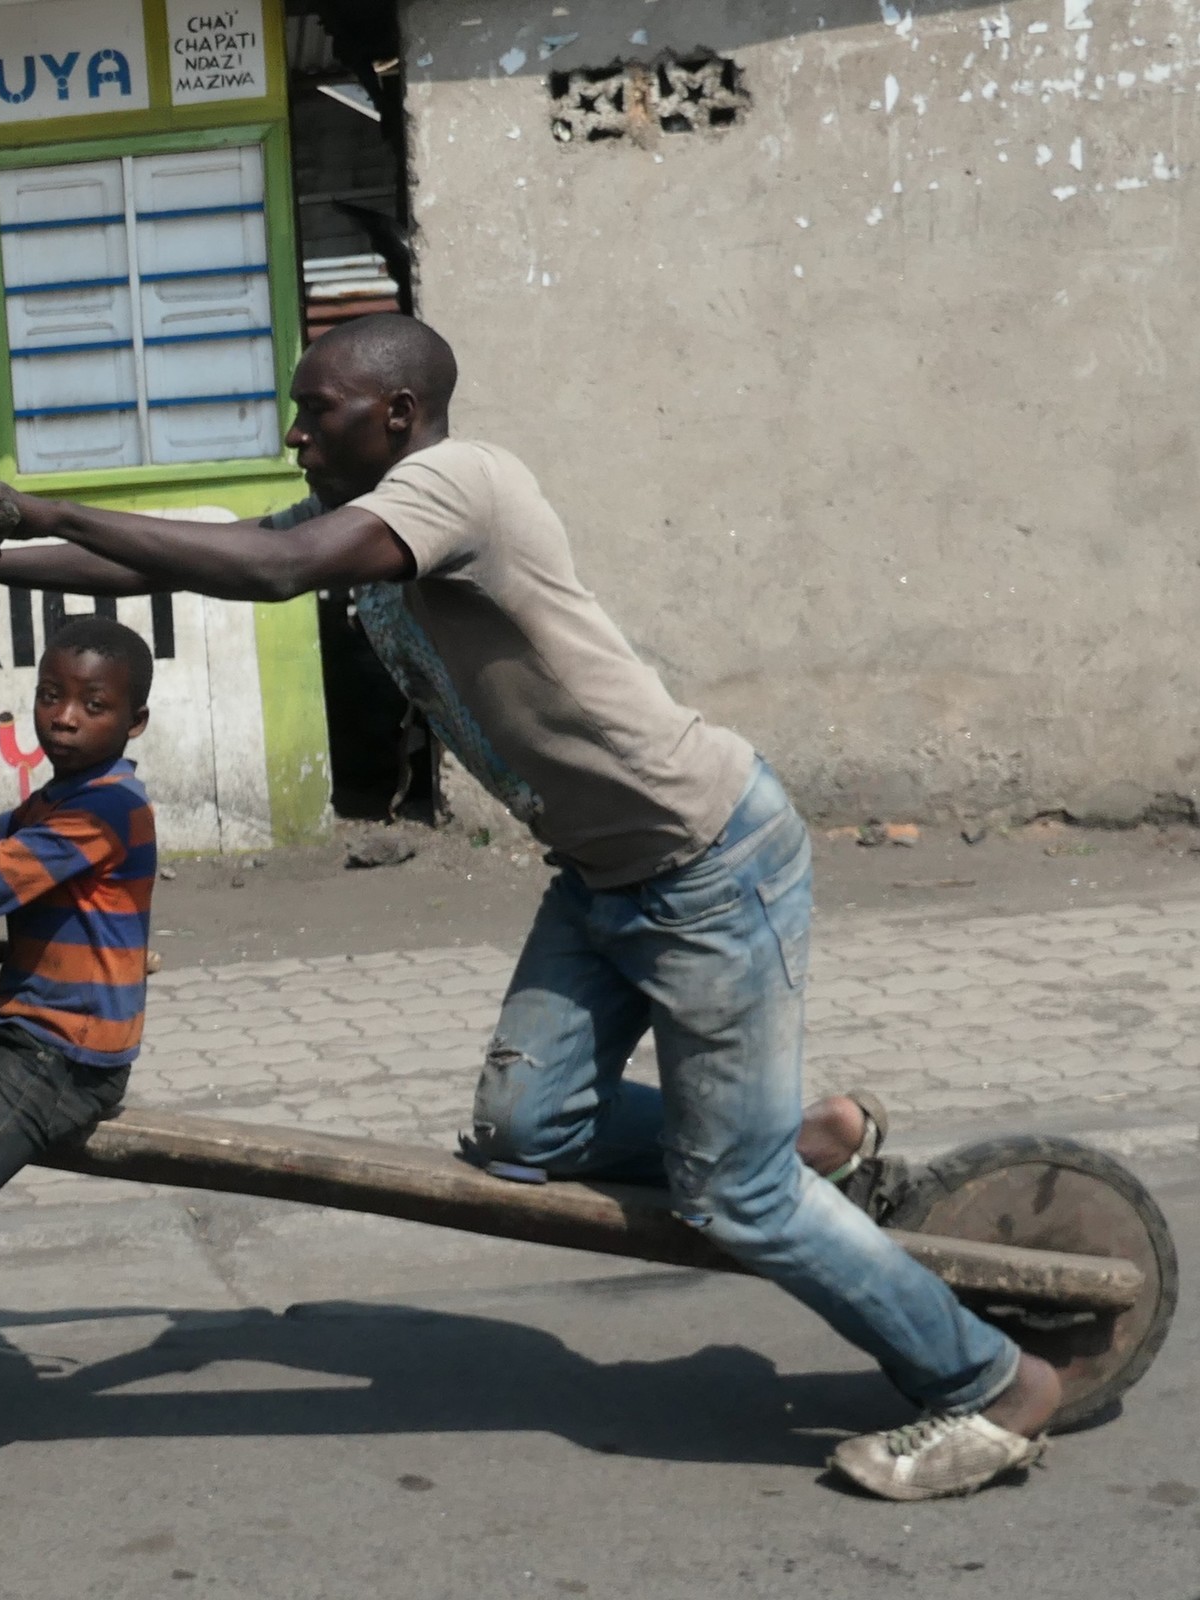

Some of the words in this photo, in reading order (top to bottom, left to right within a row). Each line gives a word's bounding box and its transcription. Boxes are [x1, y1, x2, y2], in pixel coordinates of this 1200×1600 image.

[173, 32, 256, 55] CHAPATI
[184, 54, 243, 71] NDAZI
[176, 72, 255, 92] MAZIWA
